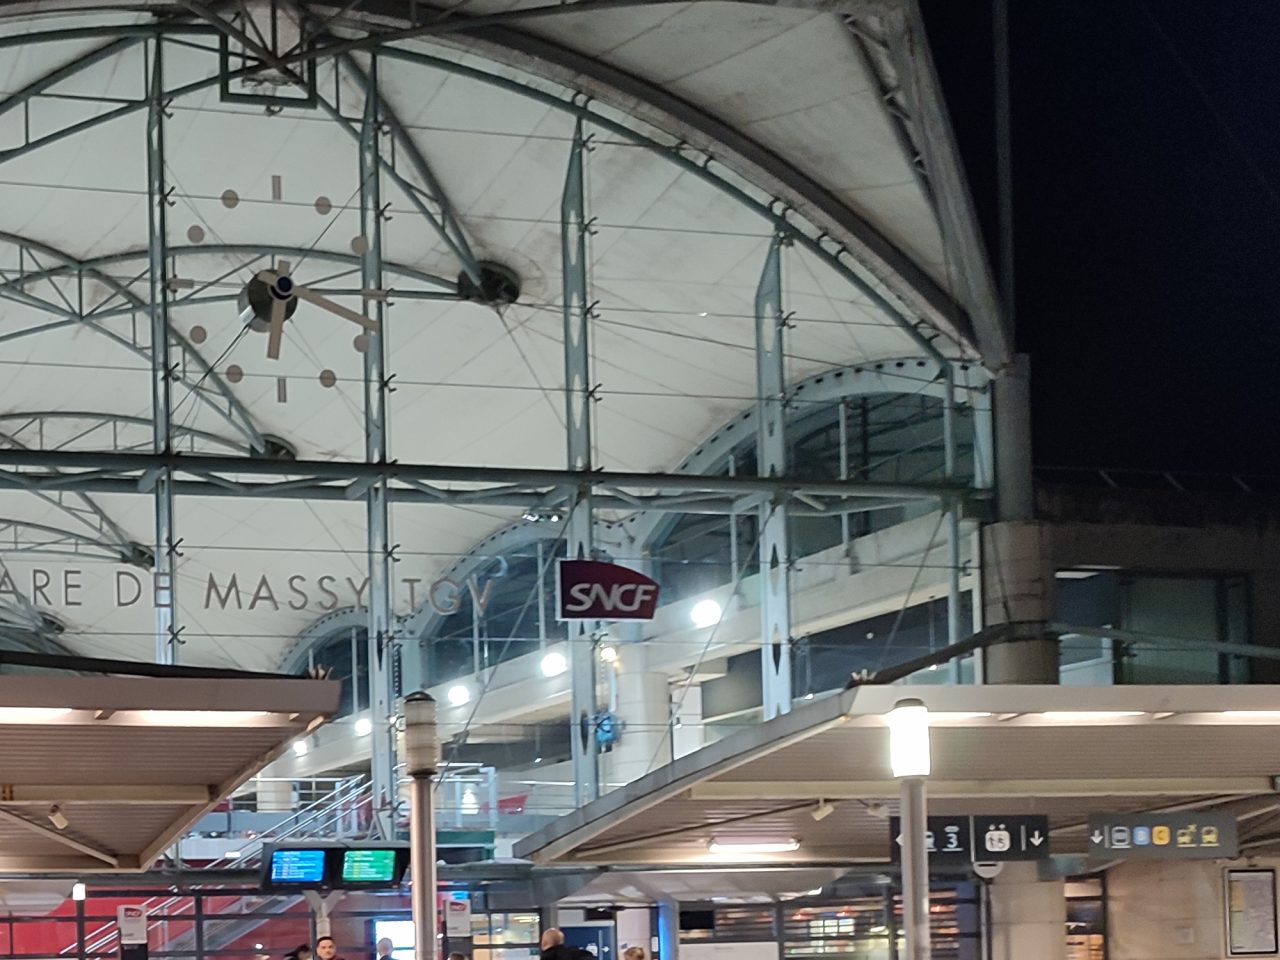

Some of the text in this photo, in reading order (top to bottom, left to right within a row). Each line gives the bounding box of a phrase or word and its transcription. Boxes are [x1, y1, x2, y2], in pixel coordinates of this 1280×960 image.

[117, 571, 173, 608] DE
[204, 572, 371, 611] MASSY
[402, 576, 495, 617] TGV
[566, 583, 656, 611] SNCF
[946, 833, 958, 848] 3
